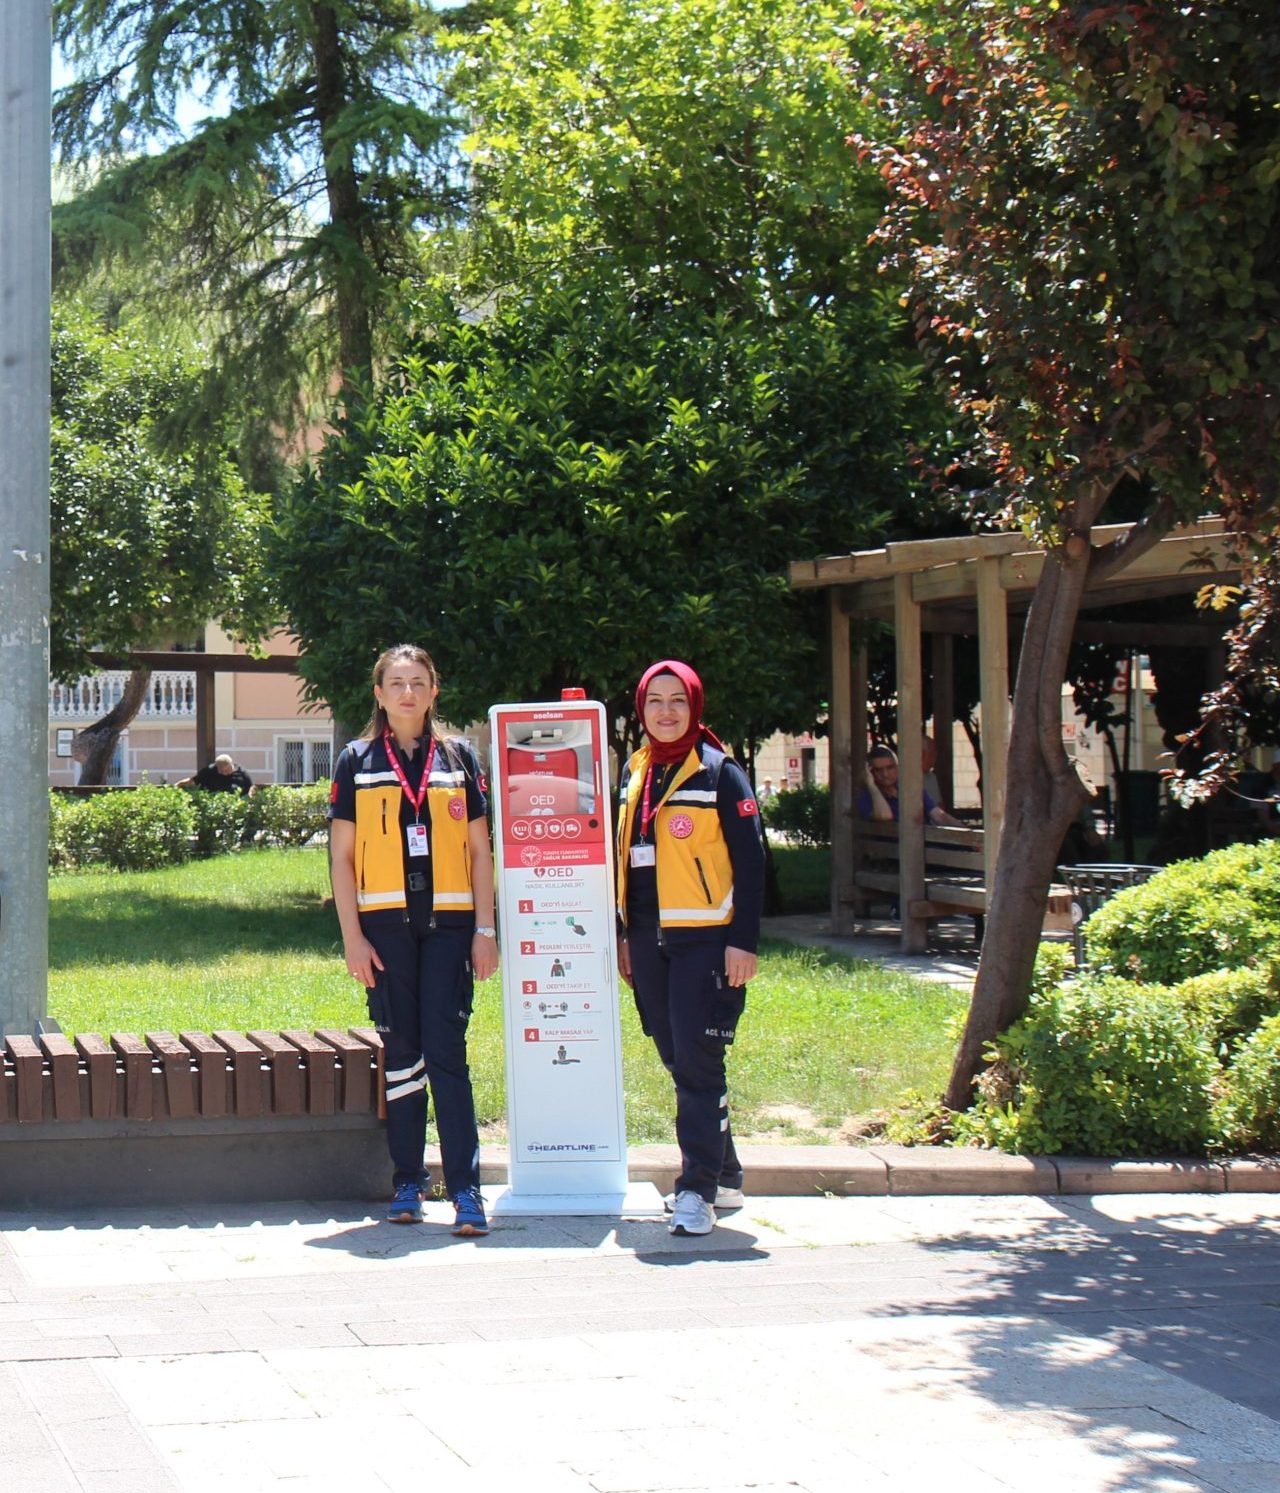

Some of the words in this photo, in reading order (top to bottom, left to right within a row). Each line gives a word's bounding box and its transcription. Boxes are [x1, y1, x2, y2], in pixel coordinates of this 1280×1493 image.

[533, 711, 564, 719] aselsan
[529, 795, 555, 805] OED
[547, 867, 573, 877] OED
[523, 903, 529, 912] 1
[525, 944, 531, 953] 2
[527, 983, 533, 993] 3
[528, 1031, 535, 1040] 4
